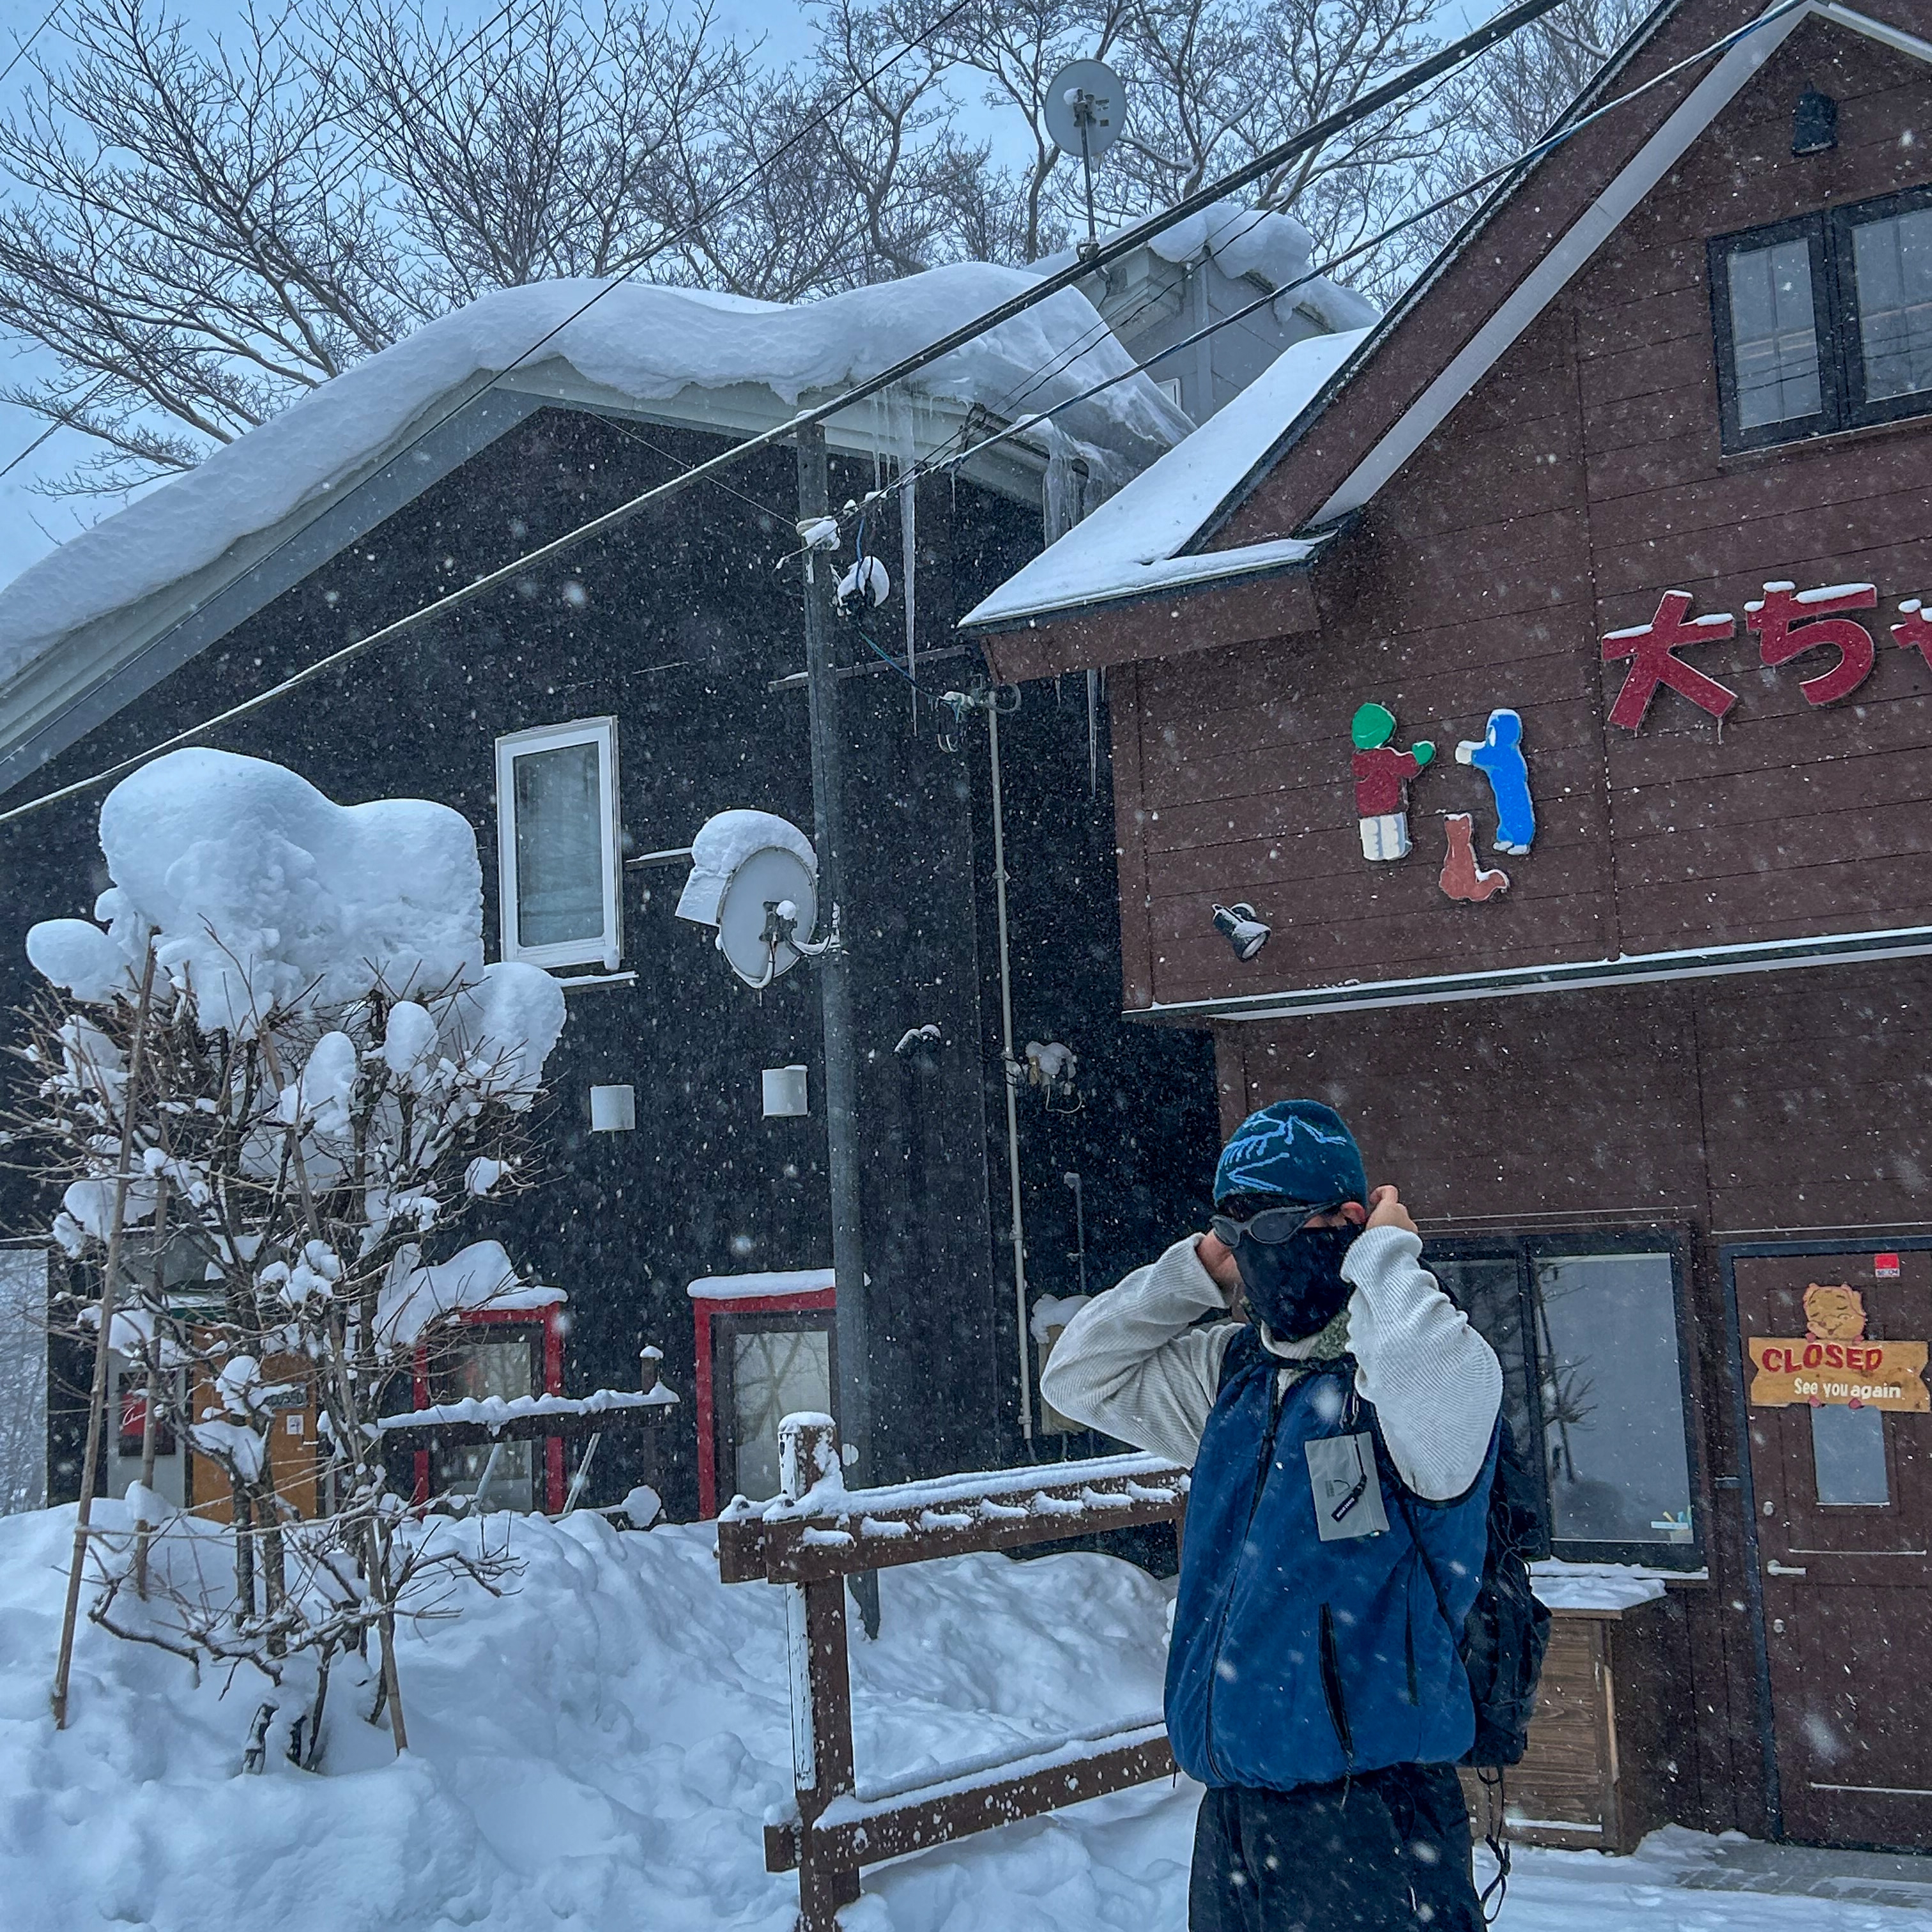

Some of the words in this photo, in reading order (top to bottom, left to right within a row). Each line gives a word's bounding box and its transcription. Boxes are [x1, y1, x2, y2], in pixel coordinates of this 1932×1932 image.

[1761, 1344, 1882, 1373] CLOSED
[1794, 1377, 1818, 1395] See
[1823, 1383, 1848, 1398] you
